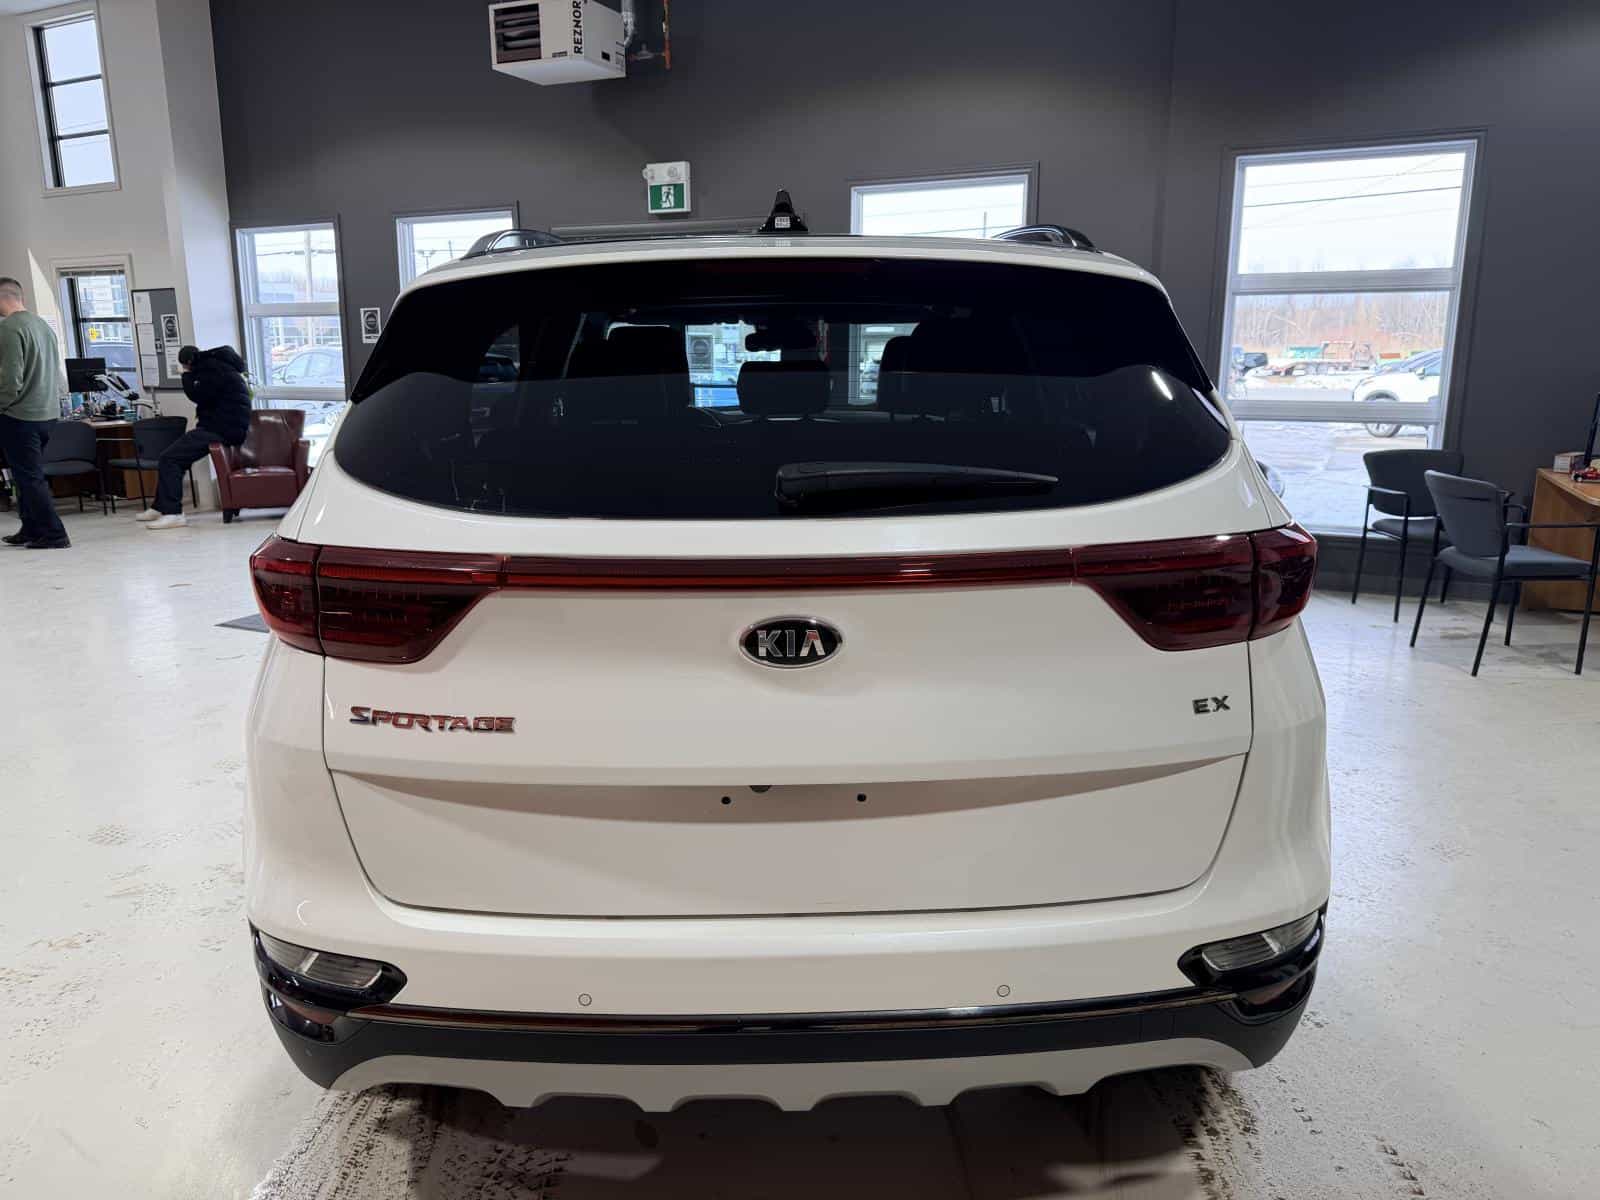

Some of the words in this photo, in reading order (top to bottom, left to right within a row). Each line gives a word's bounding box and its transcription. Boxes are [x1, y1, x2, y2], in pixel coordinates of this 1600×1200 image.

[572, 0, 583, 54] REZNOR
[756, 629, 826, 657] KIA
[1192, 695, 1231, 714] EX
[350, 705, 516, 733] SPORTAGE
